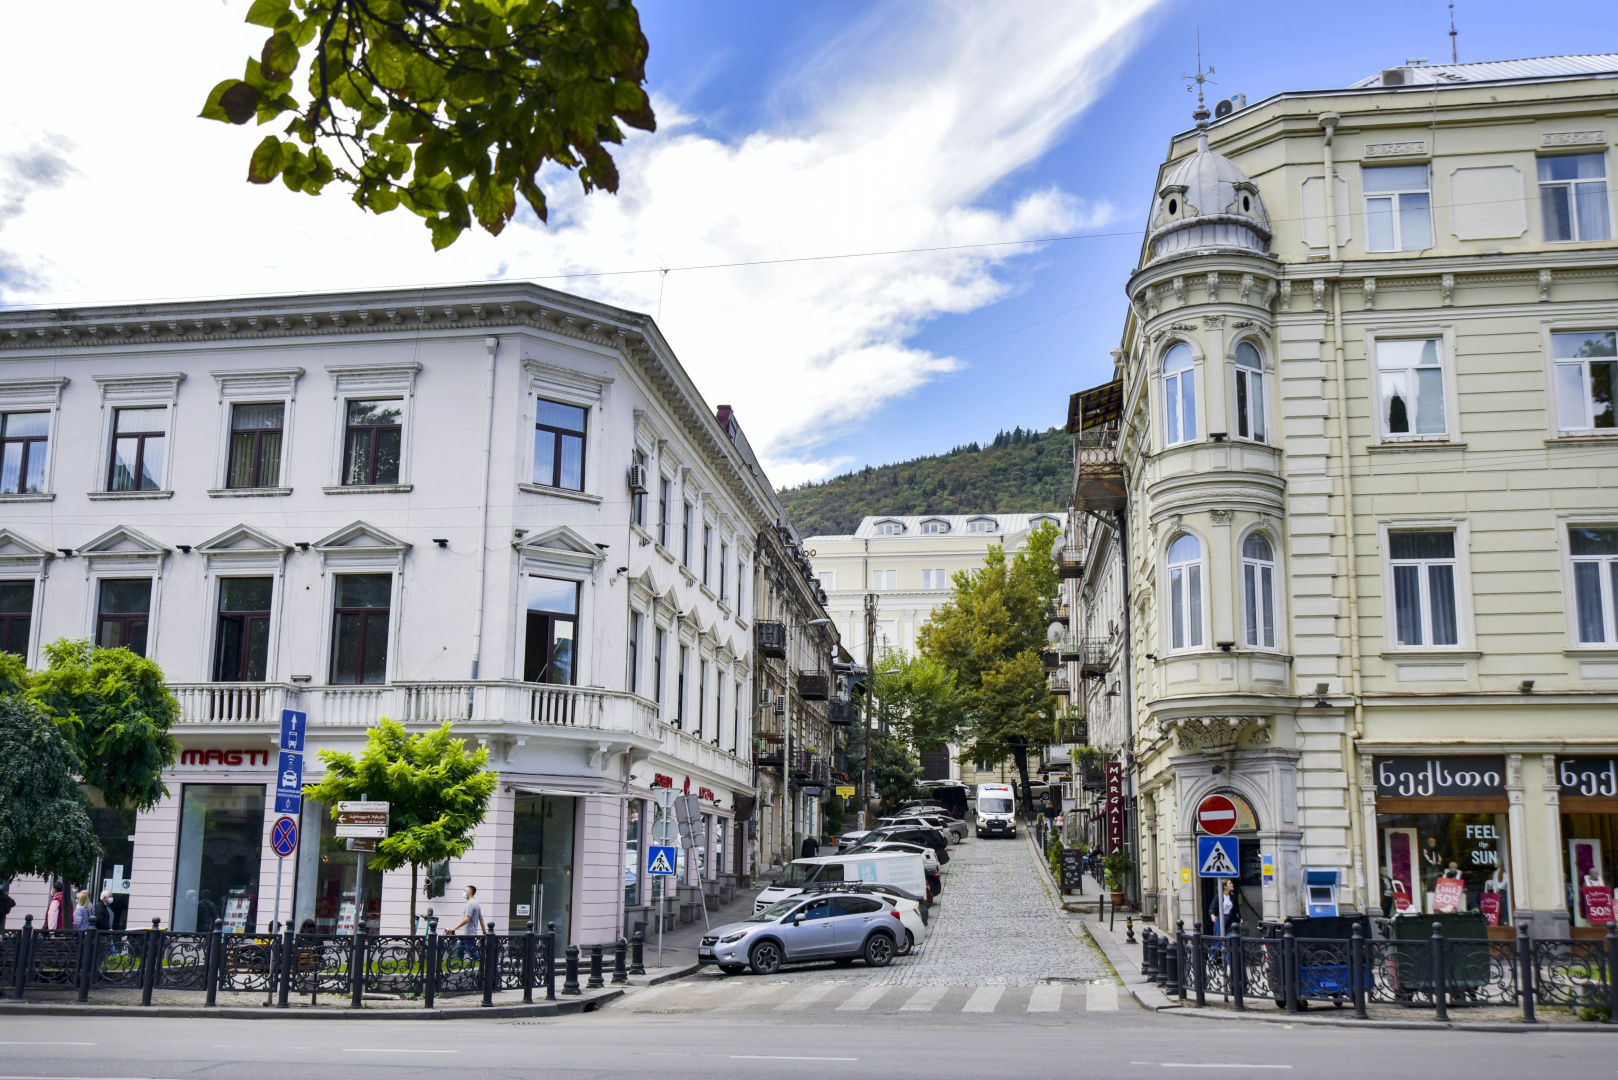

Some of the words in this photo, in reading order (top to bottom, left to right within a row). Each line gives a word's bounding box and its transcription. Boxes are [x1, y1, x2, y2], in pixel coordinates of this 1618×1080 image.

[181, 750, 268, 765] MAGTI
[1379, 760, 1500, 796] ნექსთი
[1109, 766, 1120, 854] MARGALITA
[1466, 825, 1500, 839] FEEL
[1471, 850, 1498, 865] SUN
[1435, 893, 1459, 904] 50%
[1589, 906, 1611, 916] 50%
